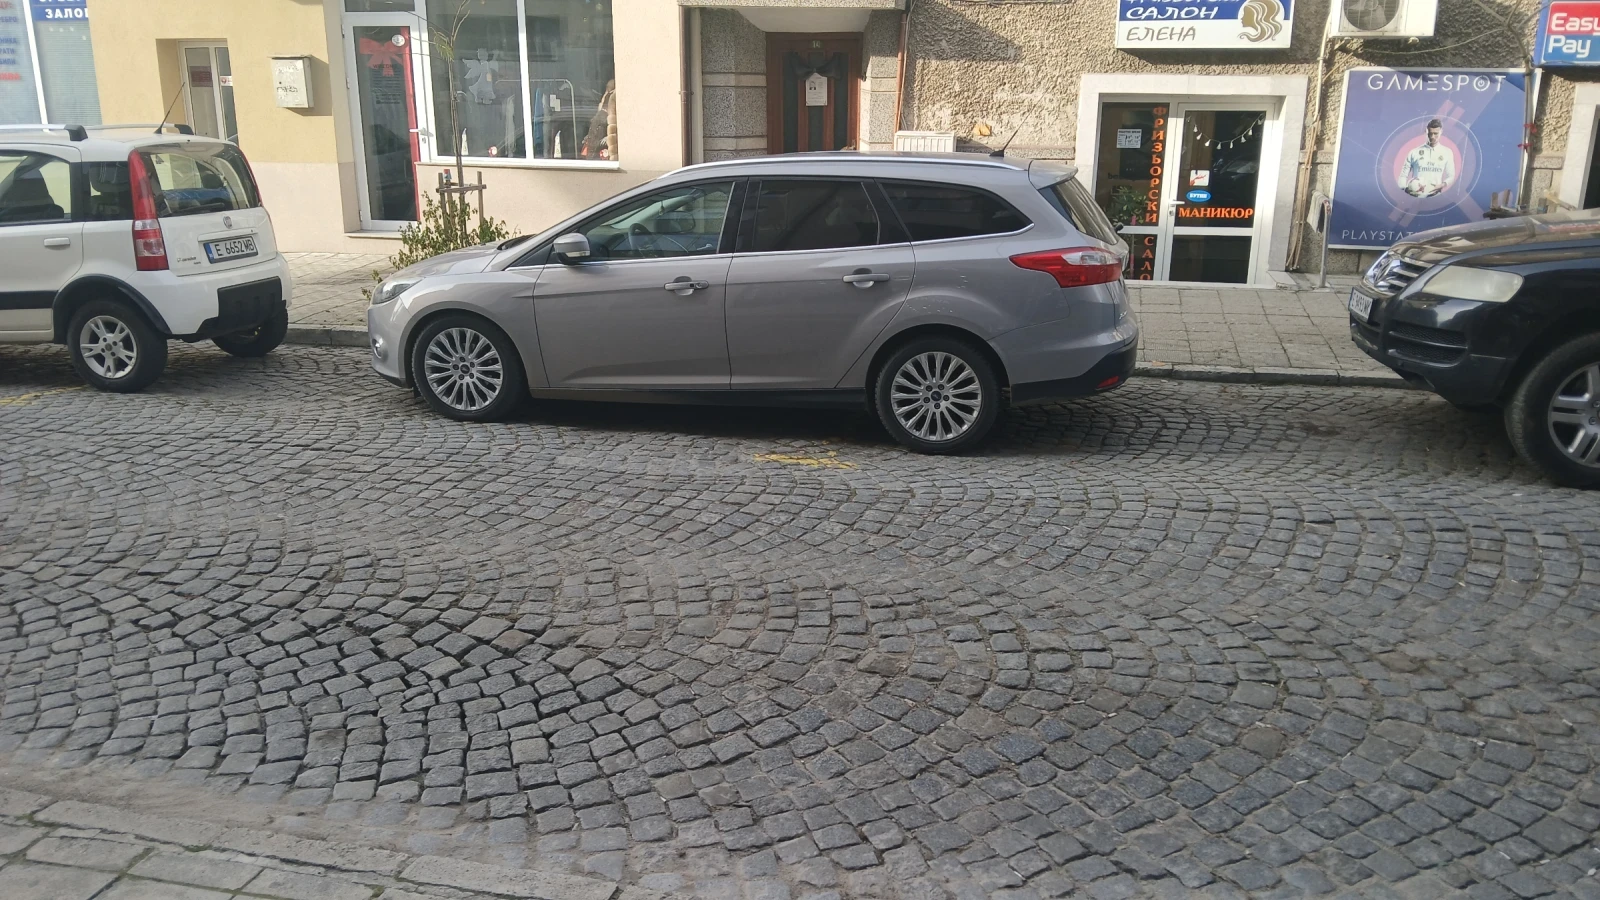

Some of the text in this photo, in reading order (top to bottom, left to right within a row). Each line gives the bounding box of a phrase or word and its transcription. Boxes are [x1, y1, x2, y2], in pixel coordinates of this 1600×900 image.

[1126, 6, 1219, 19] САЛОН
[1126, 26, 1197, 42] ЕЛЕНА
[1548, 35, 1592, 58] Pay
[1367, 73, 1507, 92] GAMESPOT
[1145, 105, 1167, 223] ФРИЗЬОРСКИ
[1178, 207, 1254, 219] МАНИКЮР
